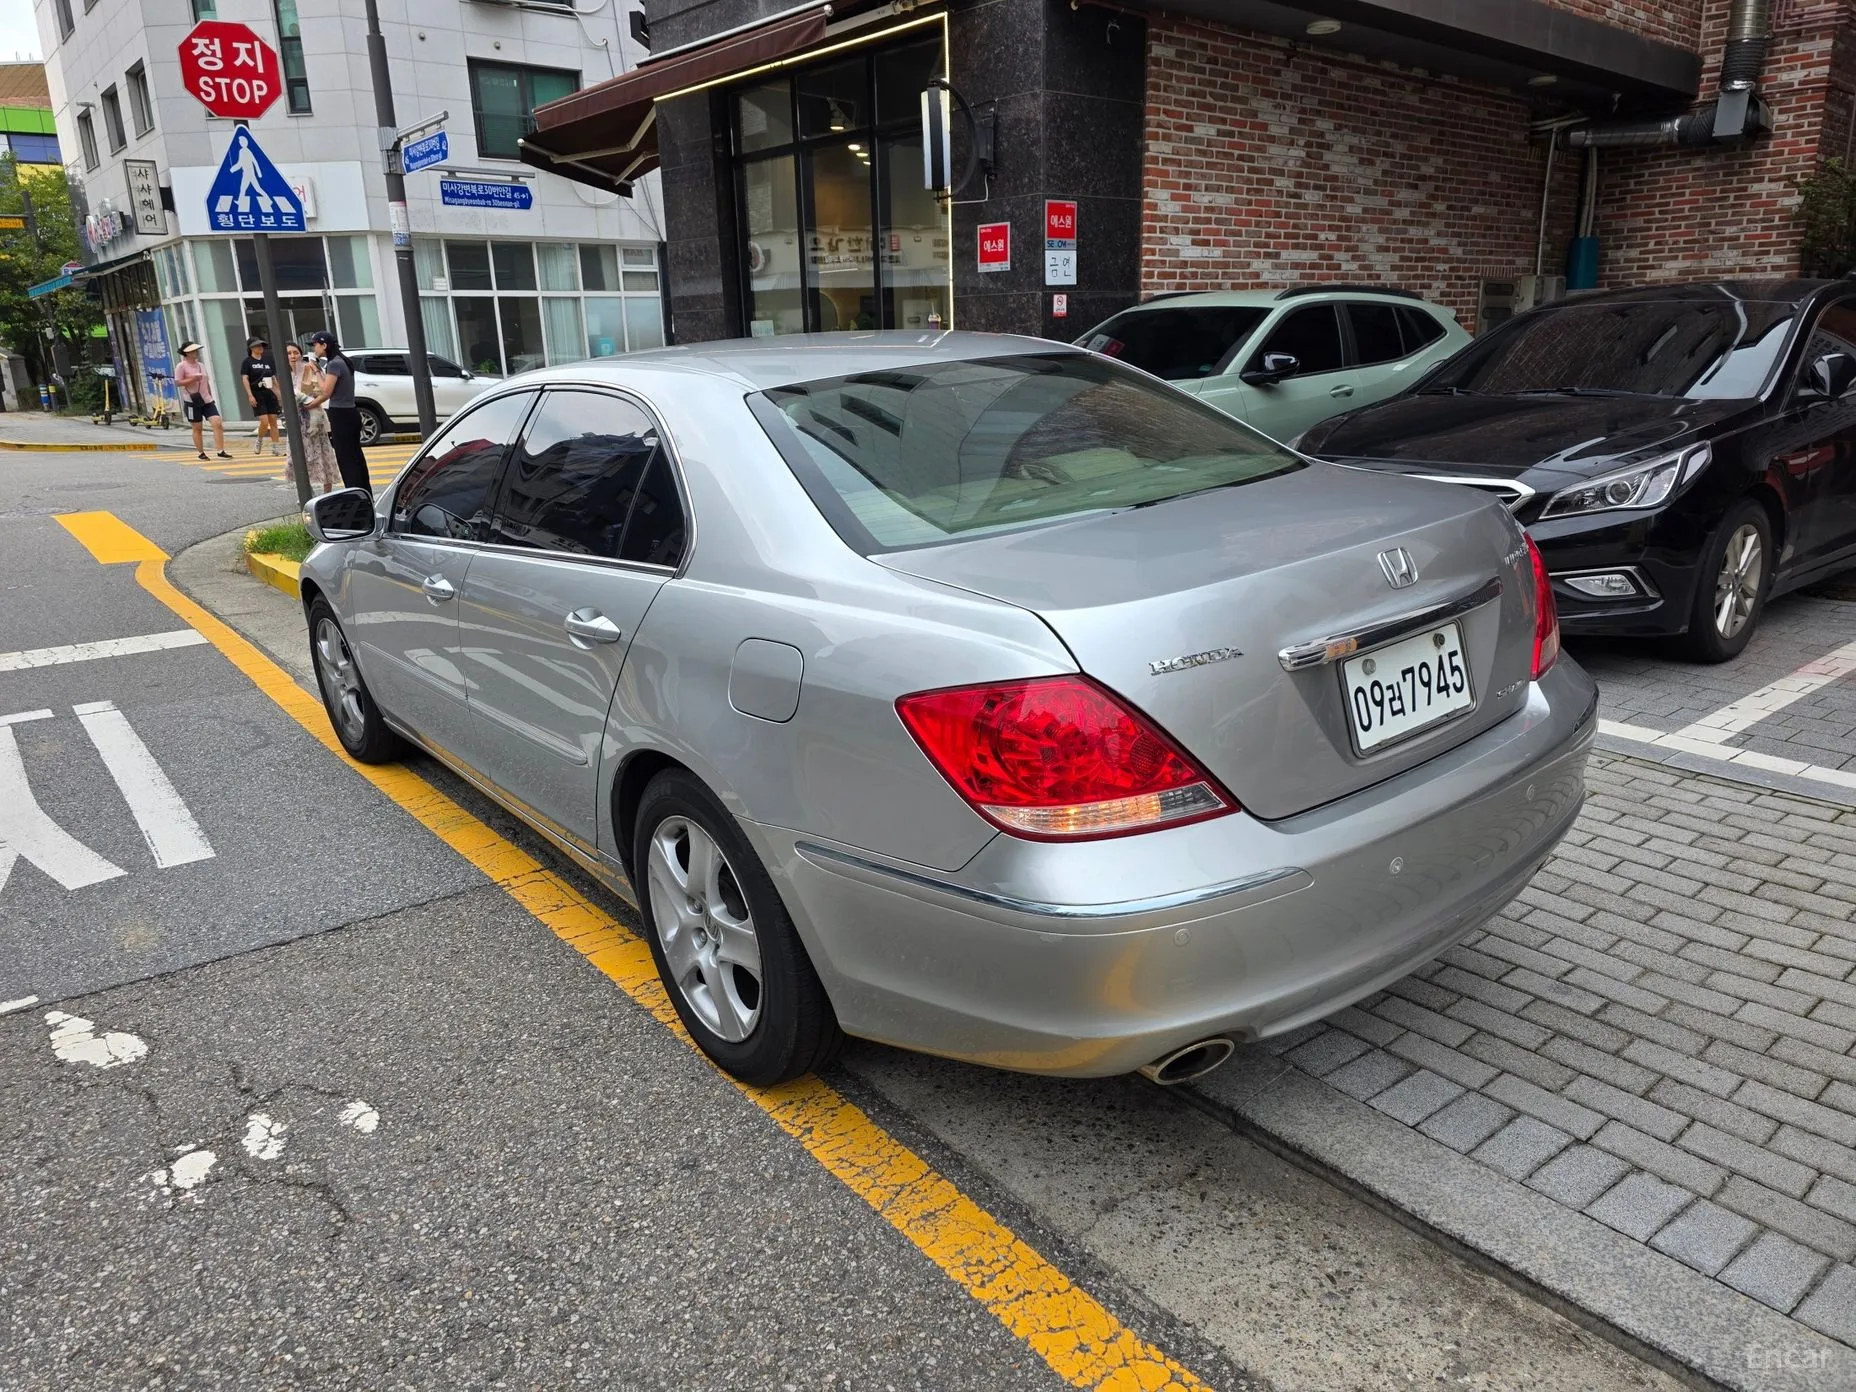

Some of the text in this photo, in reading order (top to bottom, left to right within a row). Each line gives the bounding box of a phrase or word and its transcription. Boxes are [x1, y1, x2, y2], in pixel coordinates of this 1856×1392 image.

[192, 38, 264, 73] 정지
[199, 76, 268, 104] STOP
[138, 168, 158, 226] 샤샤헤어
[442, 182, 512, 198] 미사강변북로30번안길
[217, 213, 298, 227] 횡단보도
[1050, 215, 1072, 228] 에스원
[983, 239, 1004, 252] 에스원
[1049, 256, 1072, 277] 금연
[1148, 648, 1244, 676] HONDA
[1354, 650, 1465, 732] 09러7945
